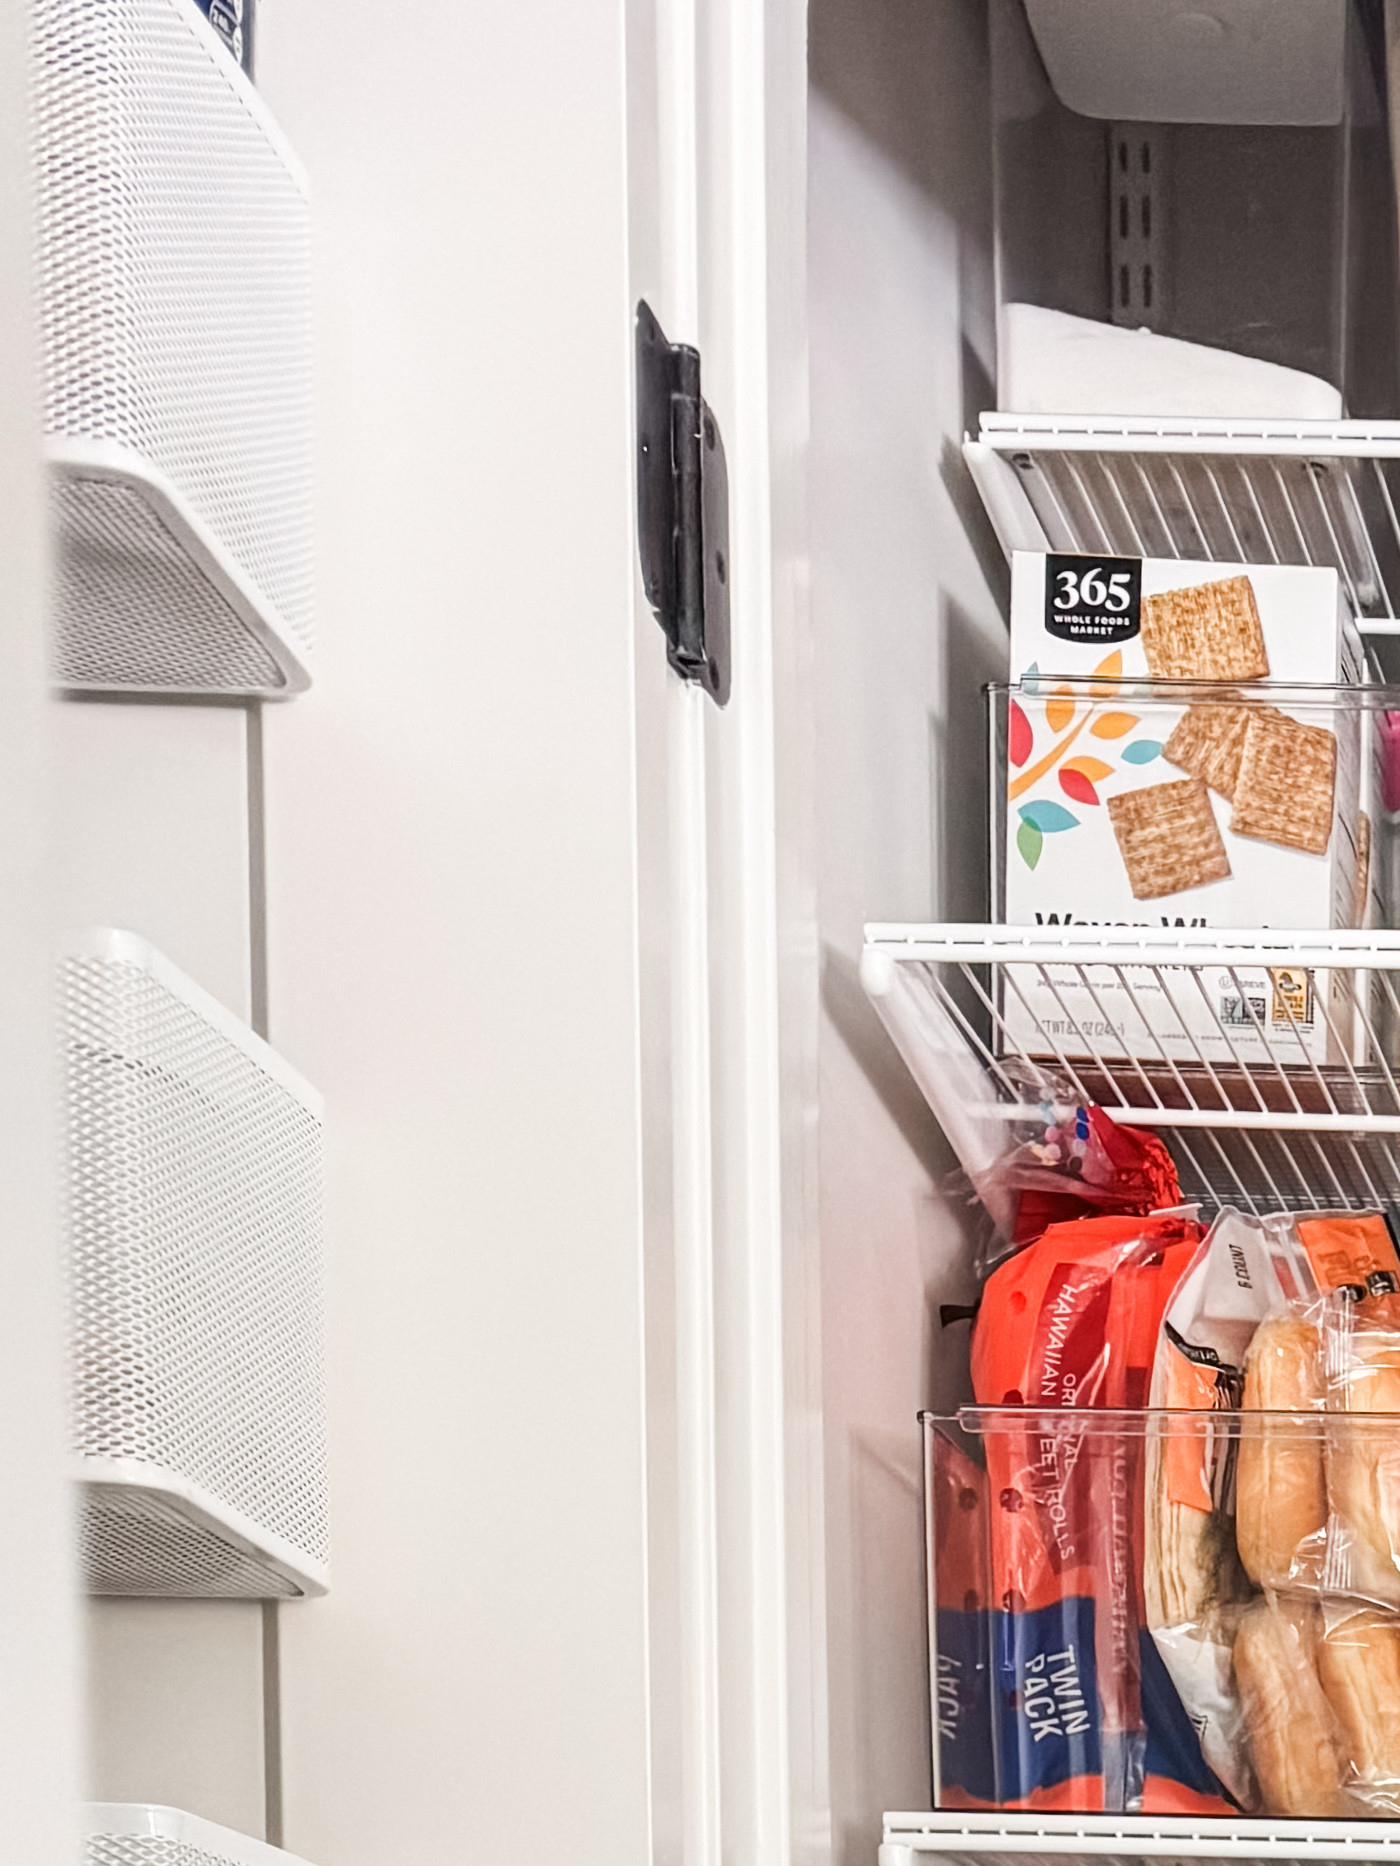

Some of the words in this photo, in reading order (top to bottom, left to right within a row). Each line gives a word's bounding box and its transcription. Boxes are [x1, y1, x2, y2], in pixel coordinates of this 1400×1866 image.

[1054, 568, 1130, 611] 365
[1054, 615, 1091, 624] WHOLE
[1041, 1284, 1078, 1397] HAWAIIAN
[1048, 1489, 1075, 1560] ROLLS
[1025, 1653, 1063, 1743] PACK
[1047, 1645, 1090, 1737] TWIN
